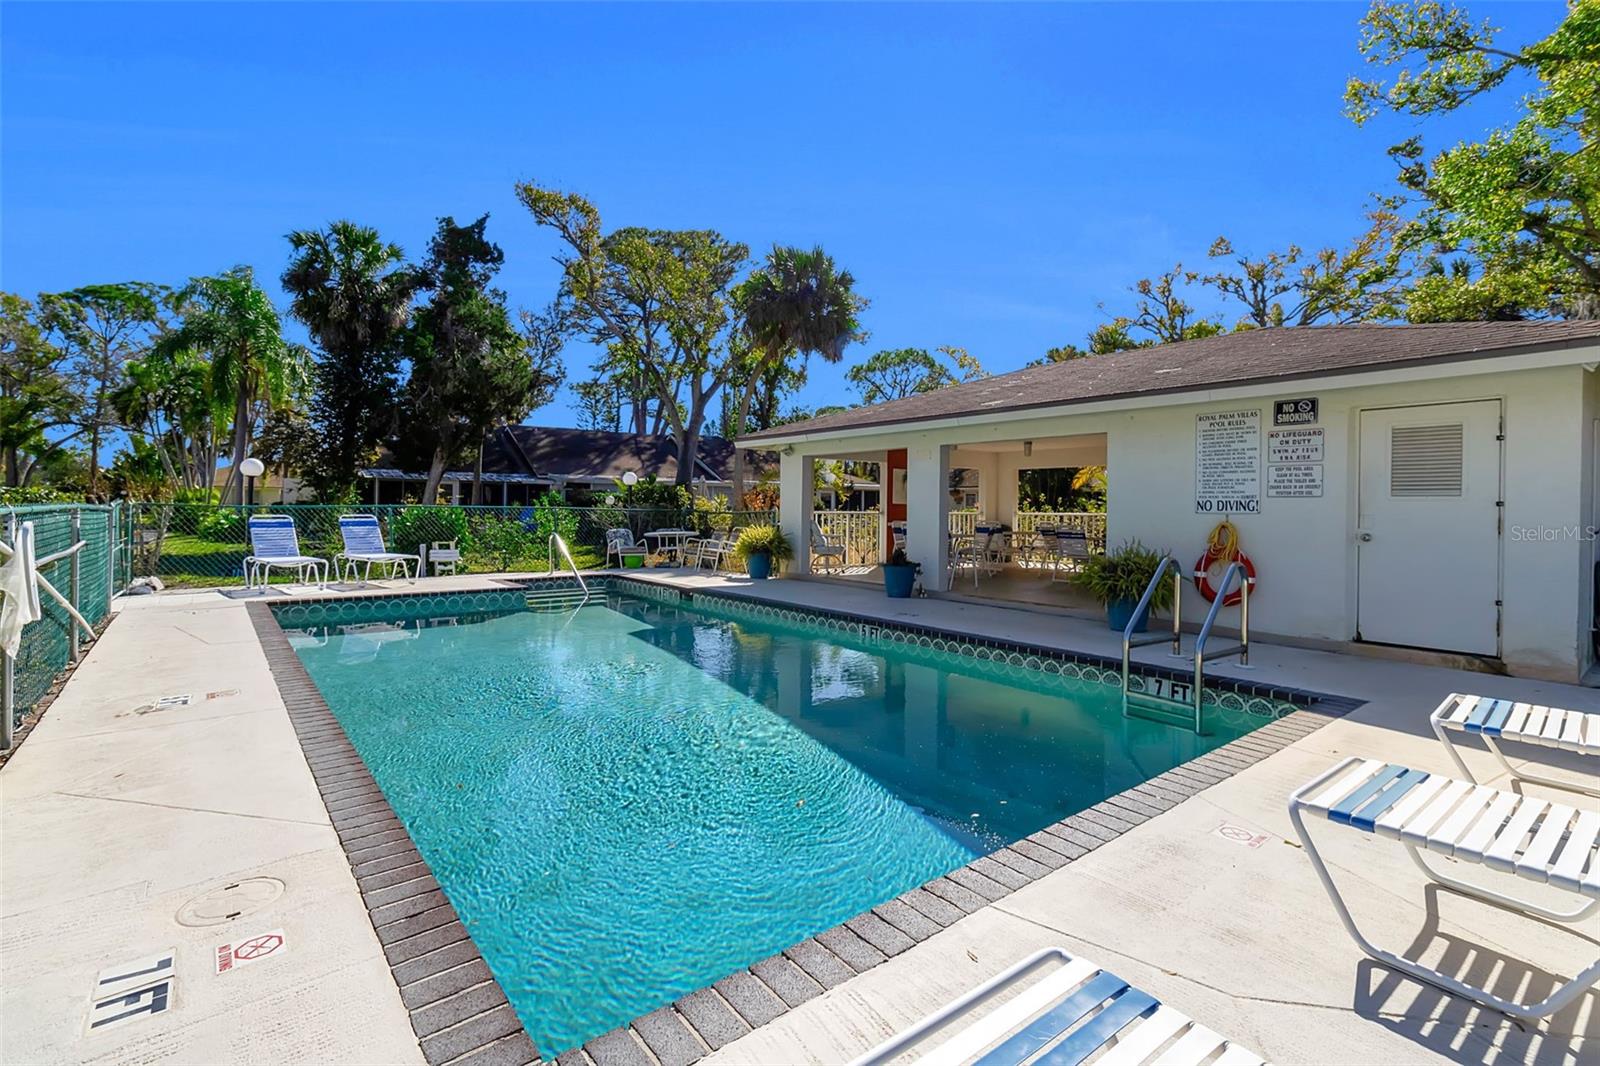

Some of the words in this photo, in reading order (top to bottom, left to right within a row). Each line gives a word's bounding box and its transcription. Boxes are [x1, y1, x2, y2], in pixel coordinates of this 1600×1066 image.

[1282, 403, 1294, 412] NO
[1277, 412, 1314, 424] SMOKING
[1282, 430, 1322, 438] LIFEGUARD
[1196, 500, 1212, 512] NO
[1217, 500, 1259, 512] DIVING!
[870, 627, 879, 638] FT
[1154, 680, 1162, 696] 7
[1171, 684, 1190, 701] FT
[90, 982, 169, 1029] FT
